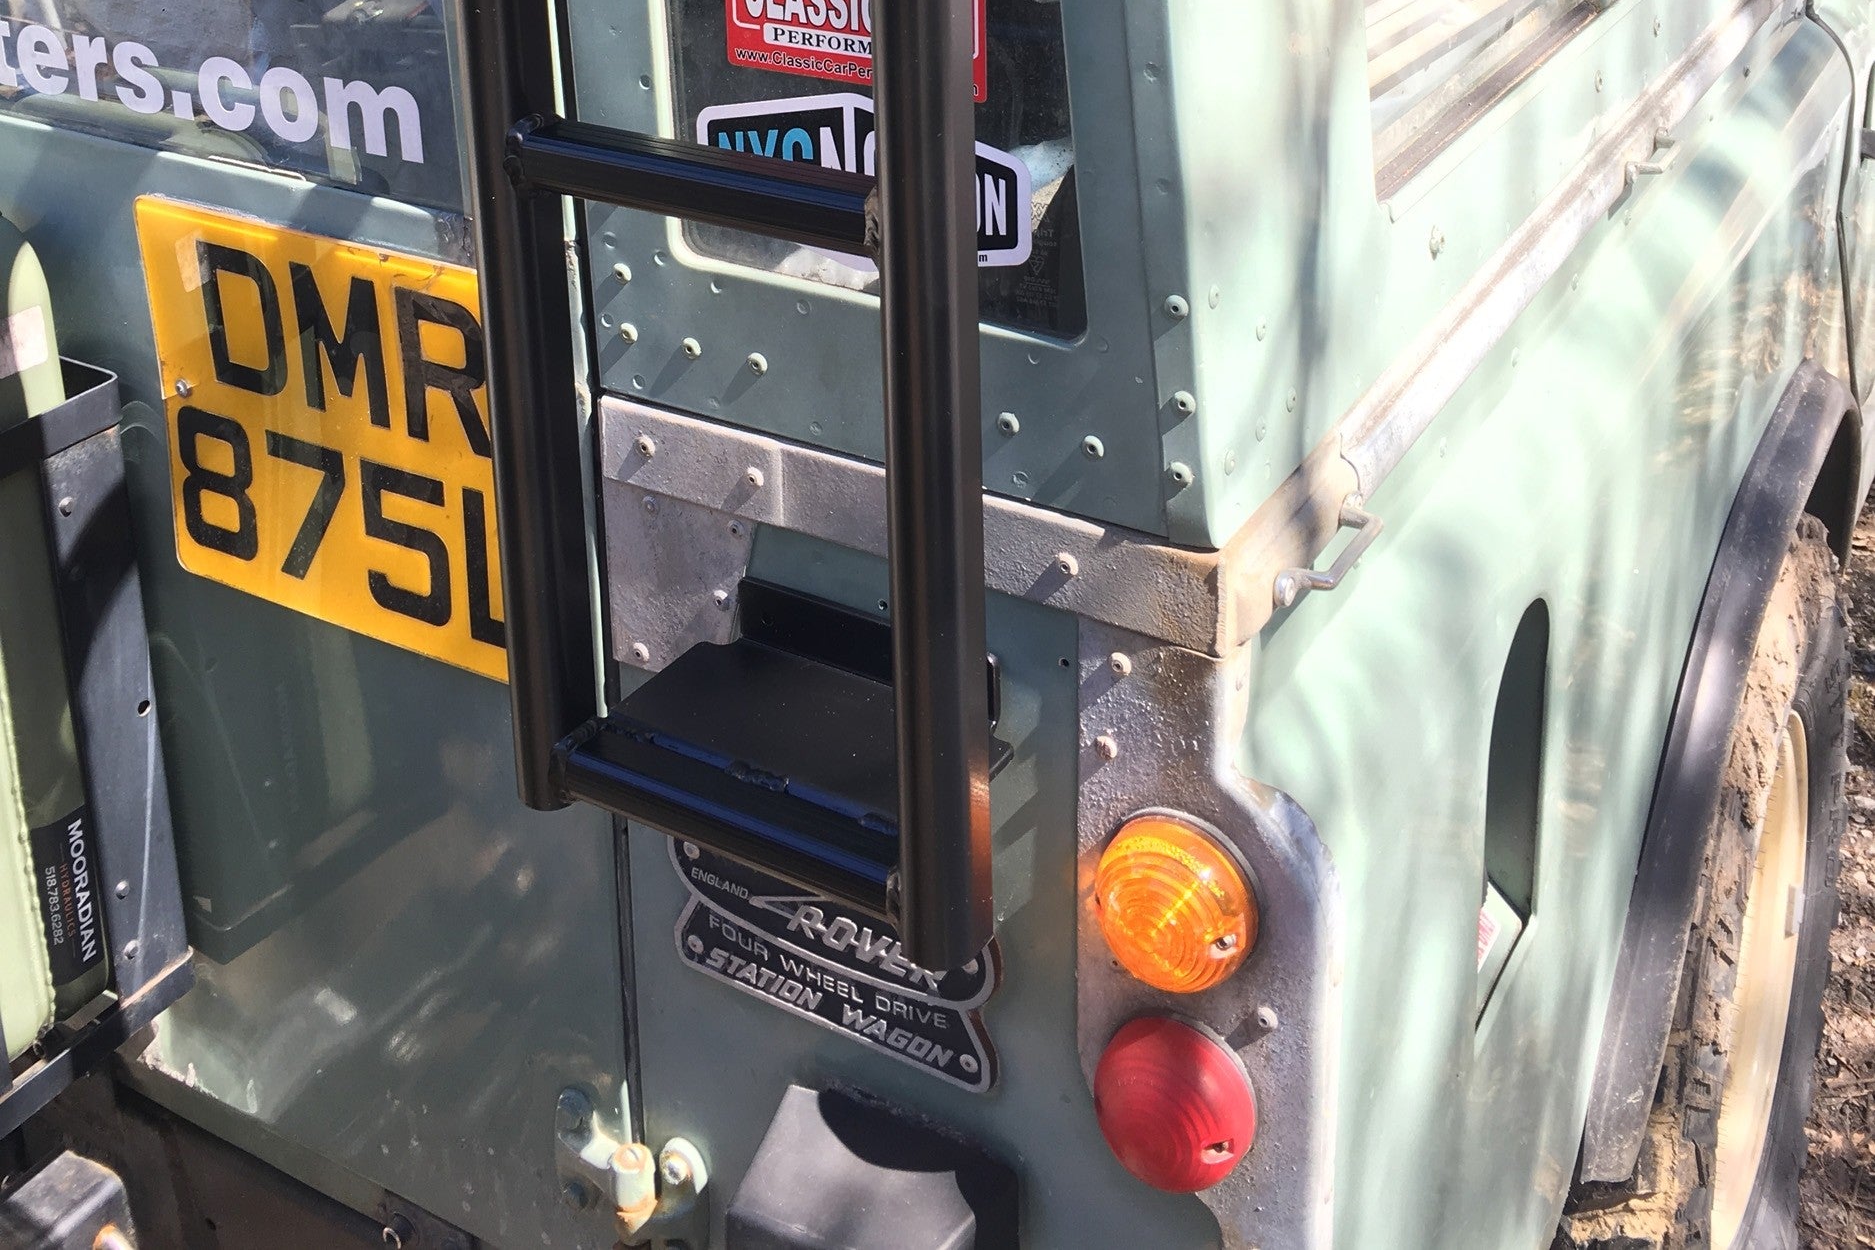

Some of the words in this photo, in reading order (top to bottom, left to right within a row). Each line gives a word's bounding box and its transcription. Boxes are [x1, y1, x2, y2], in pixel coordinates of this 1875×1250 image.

[195, 238, 492, 459] DMR
[177, 406, 507, 649] 875L
[45, 865, 64, 946] 518.783.6282
[59, 862, 76, 938] HYDRAULICS
[67, 818, 97, 963] MOORADIAN
[690, 867, 749, 901] ENGLAND
[705, 949, 823, 1011] STATION
[841, 1003, 957, 1069] WAGON
[708, 914, 769, 962] FOUR
[779, 954, 864, 1004] WHEEL
[875, 994, 948, 1030] DRIVE
